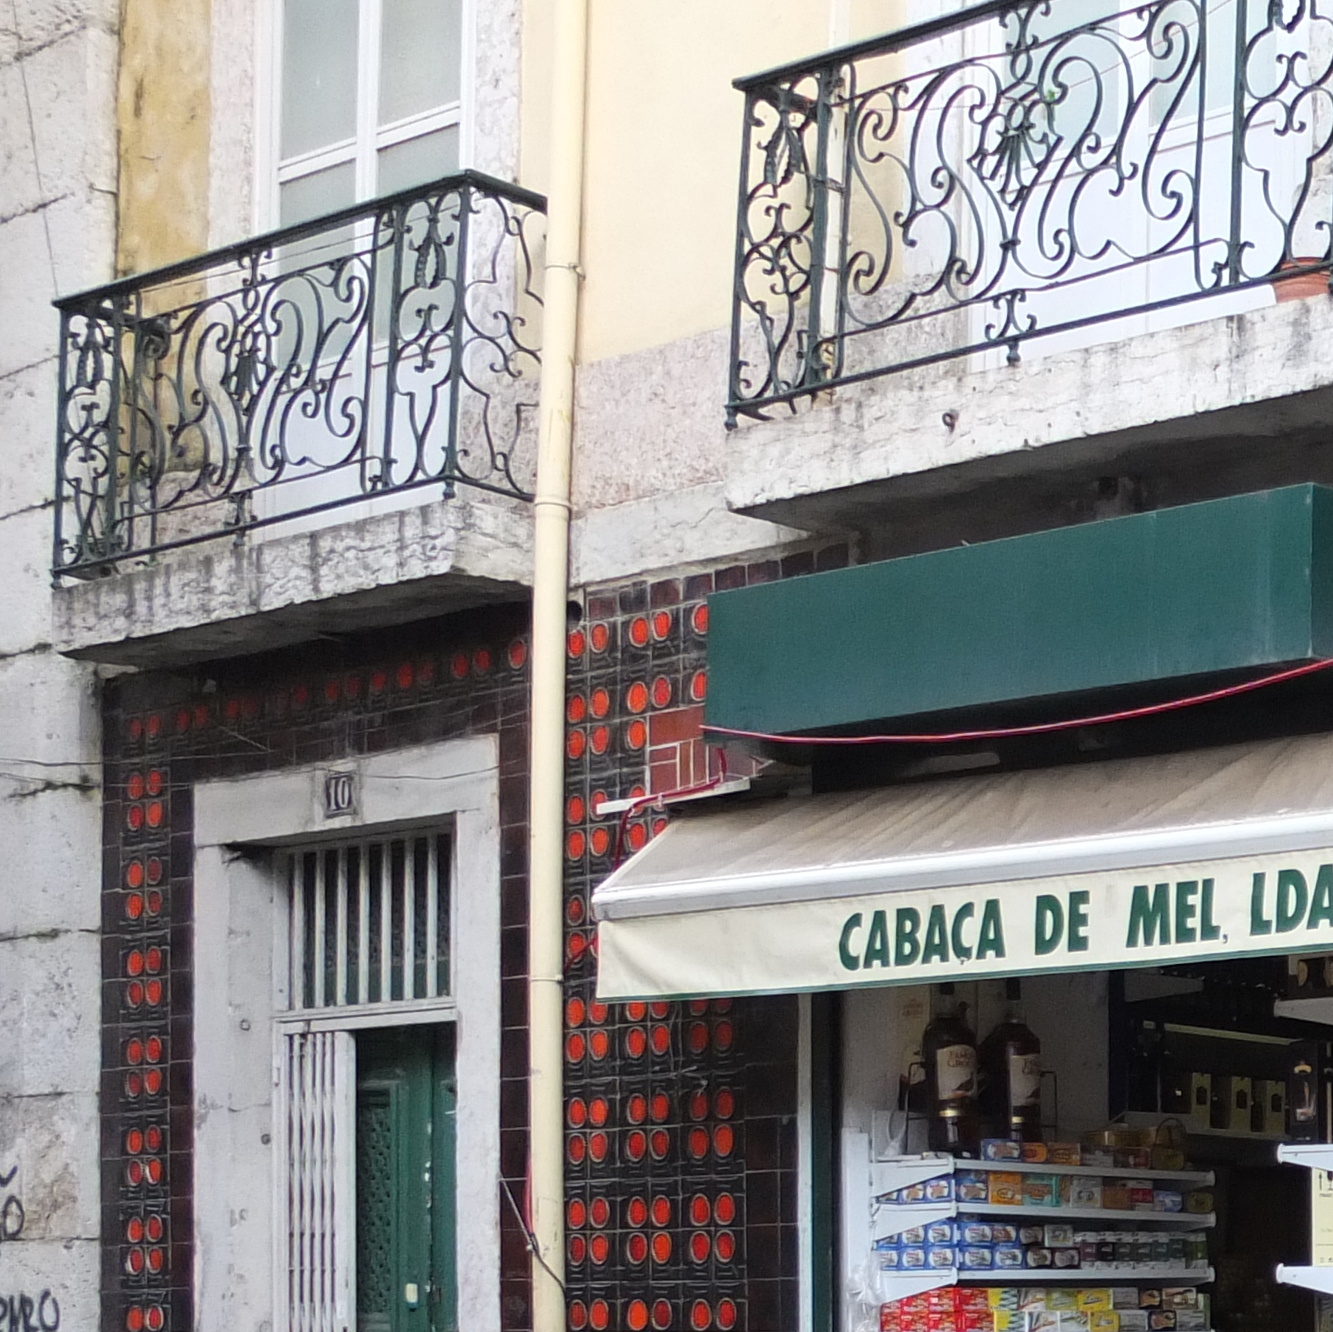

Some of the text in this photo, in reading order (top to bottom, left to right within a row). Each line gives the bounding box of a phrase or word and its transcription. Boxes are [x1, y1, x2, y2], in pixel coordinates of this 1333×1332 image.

[331, 777, 349, 810] 10
[838, 898, 1006, 972] CABAÇA
[1034, 890, 1090, 956] DE
